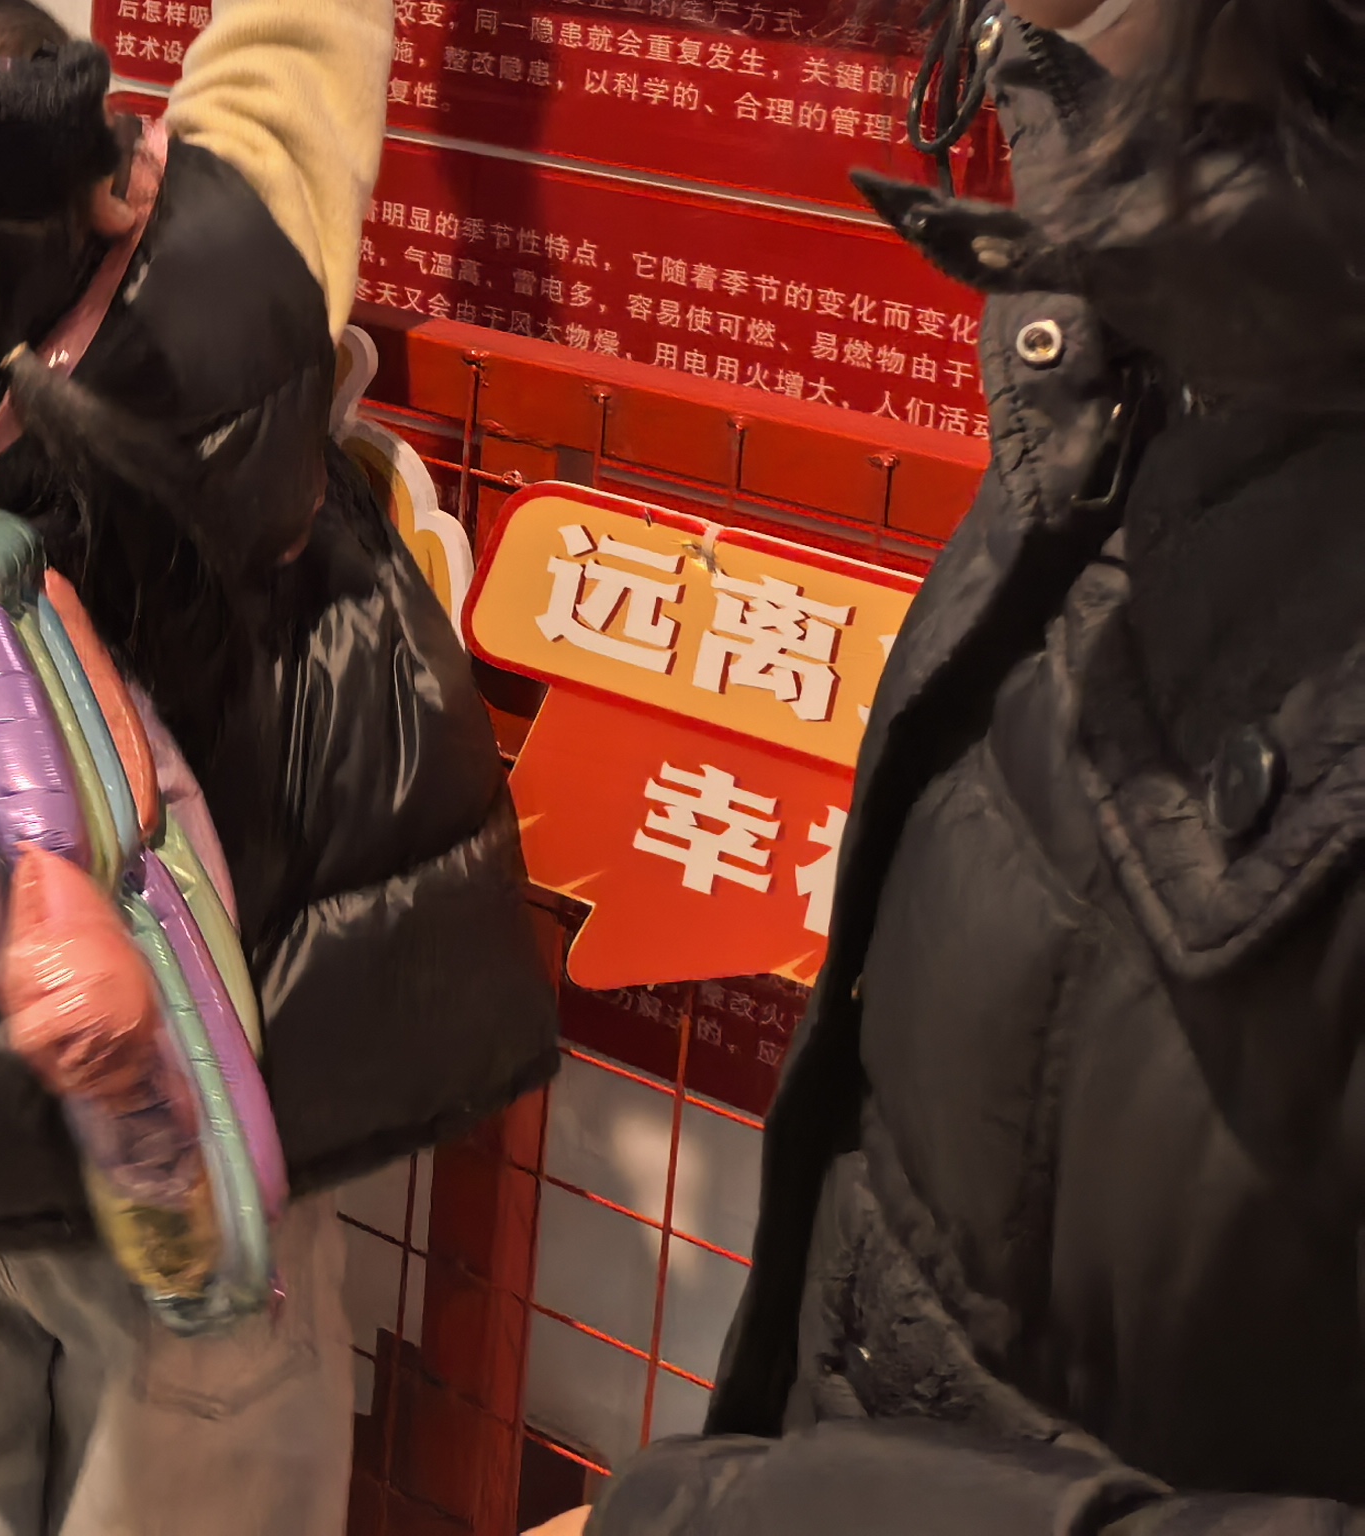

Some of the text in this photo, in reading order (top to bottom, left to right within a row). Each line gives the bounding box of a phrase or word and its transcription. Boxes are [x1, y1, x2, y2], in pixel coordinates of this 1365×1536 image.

[115, 31, 185, 65] 技术设
[534, 524, 897, 726] 远离
